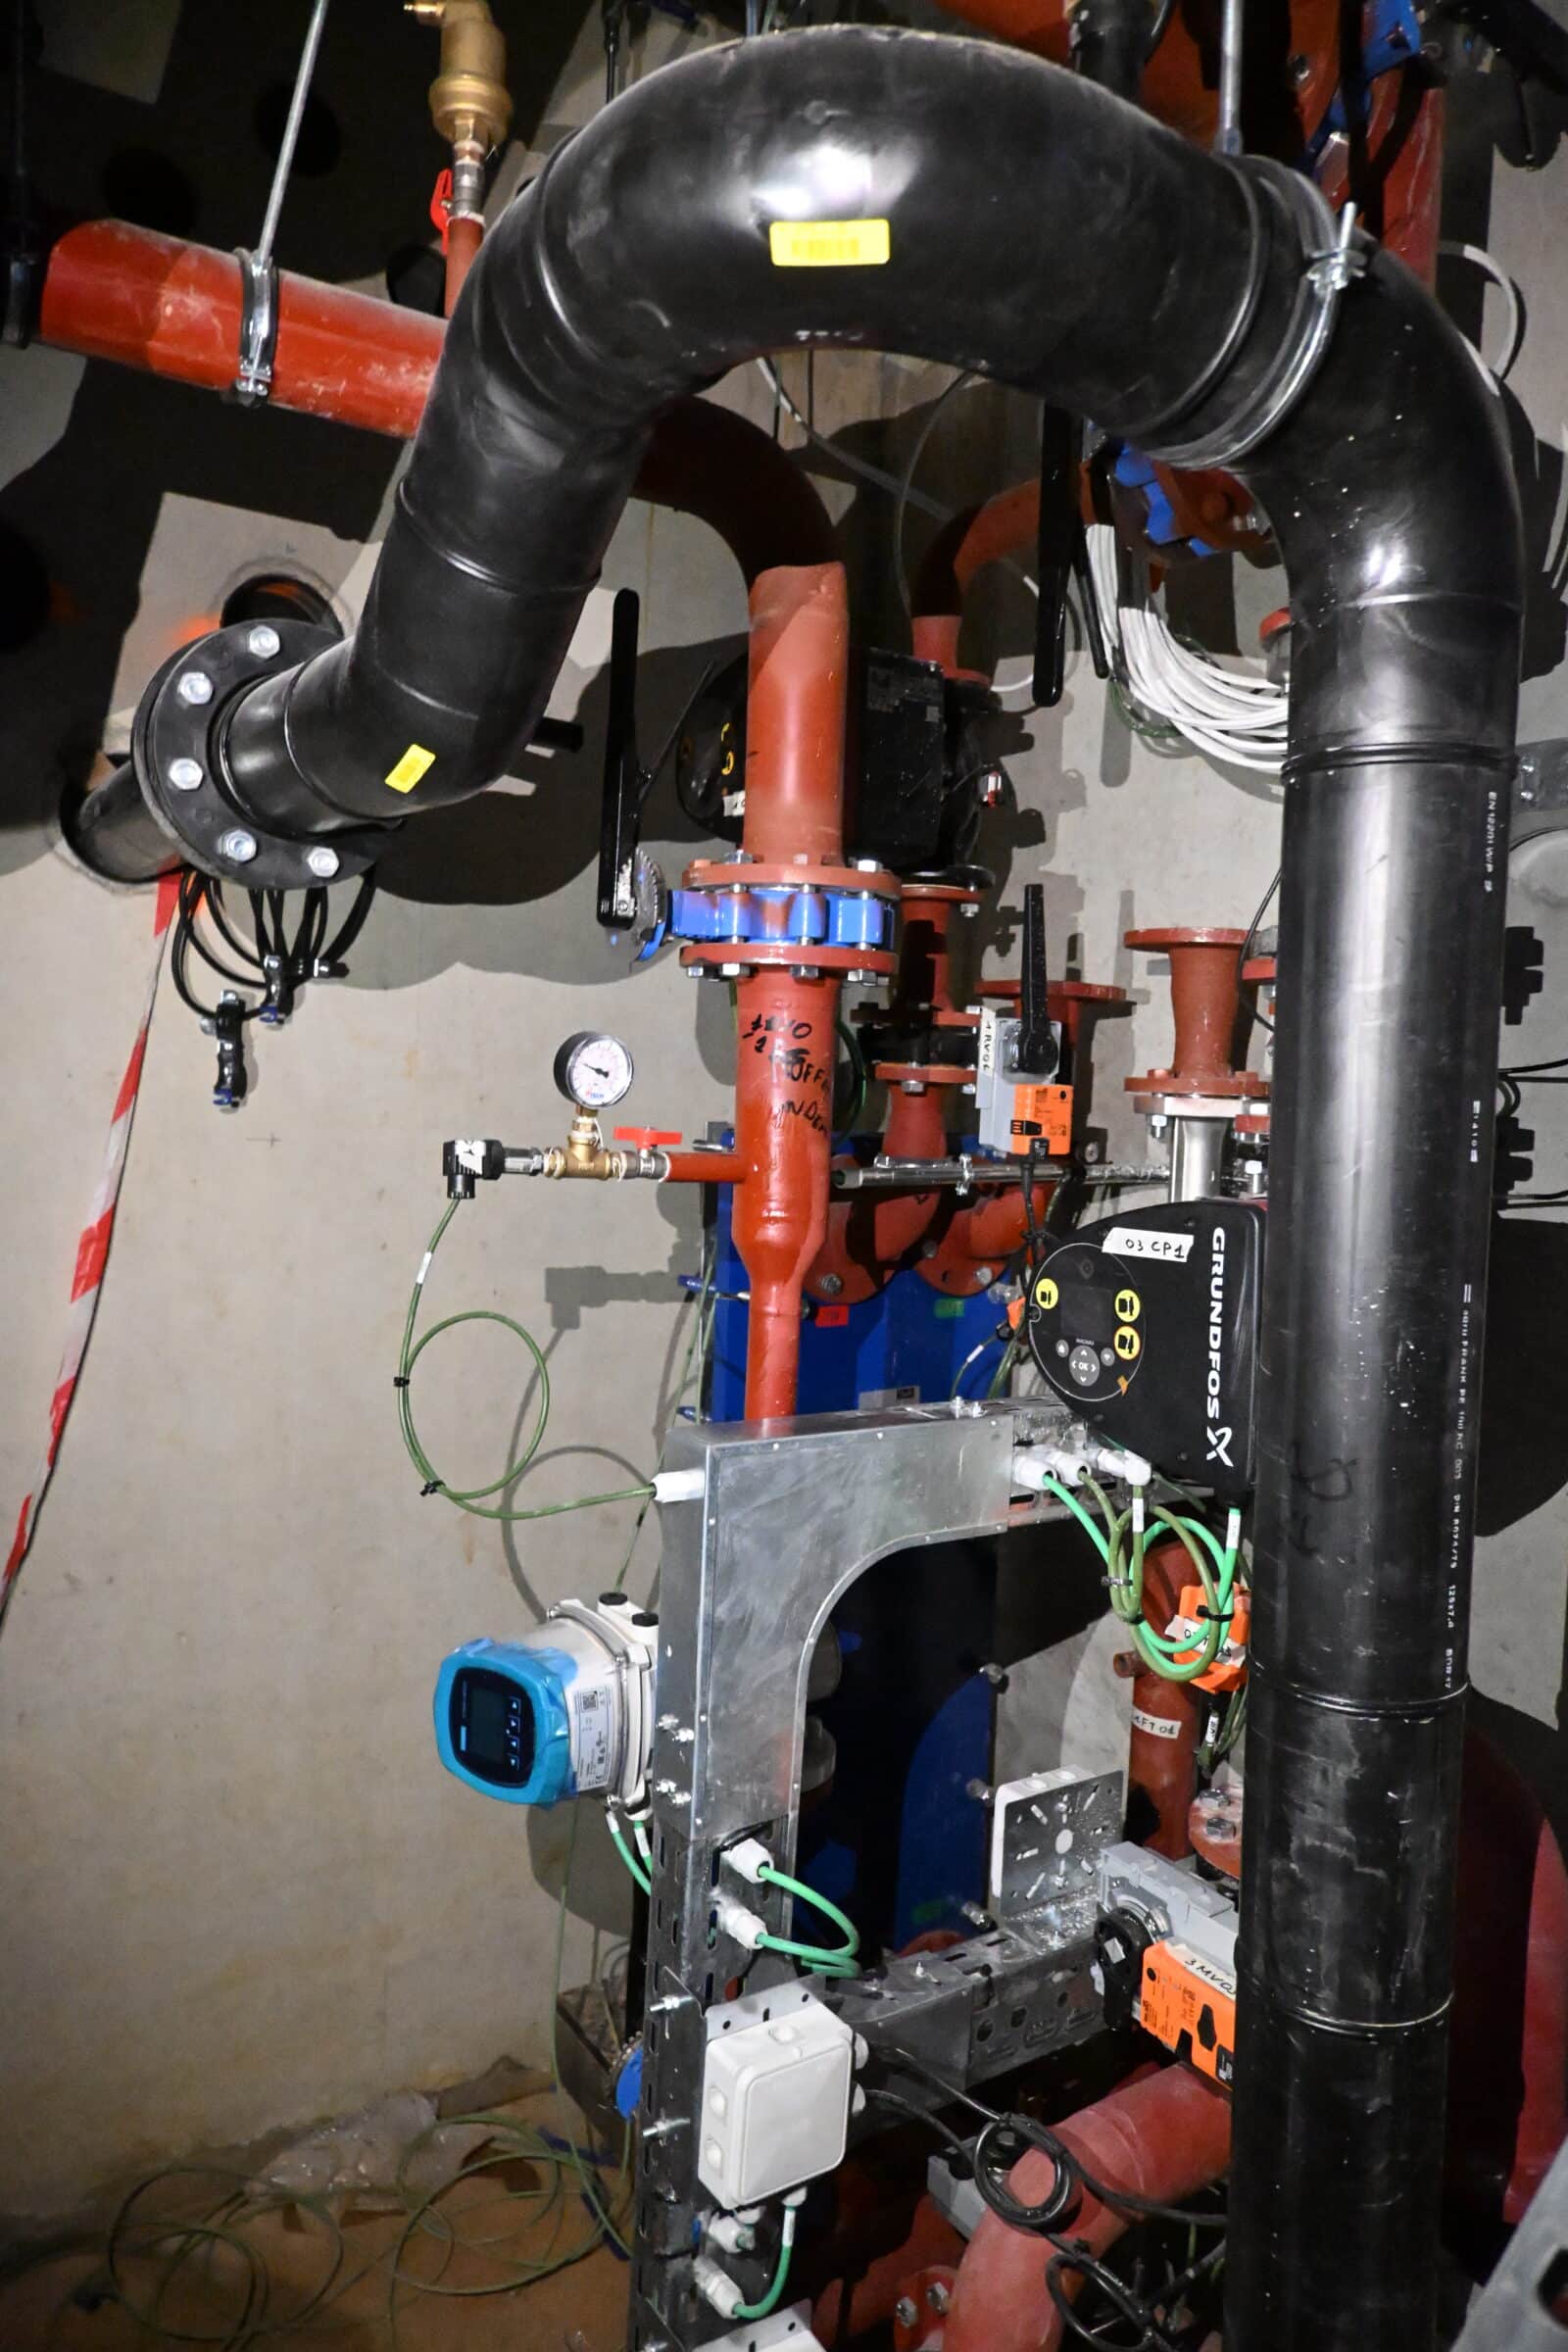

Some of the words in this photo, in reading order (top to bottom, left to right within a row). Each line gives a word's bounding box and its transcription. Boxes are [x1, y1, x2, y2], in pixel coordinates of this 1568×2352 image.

[1487, 791, 1497, 810] EN
[1125, 1239, 1144, 1252] 03
[1151, 1241, 1186, 1259] CP1
[1206, 1227, 1225, 1419] GRUNDFOS
[1459, 1340, 1468, 1384] FRANK
[1458, 1388, 1466, 1404] PE
